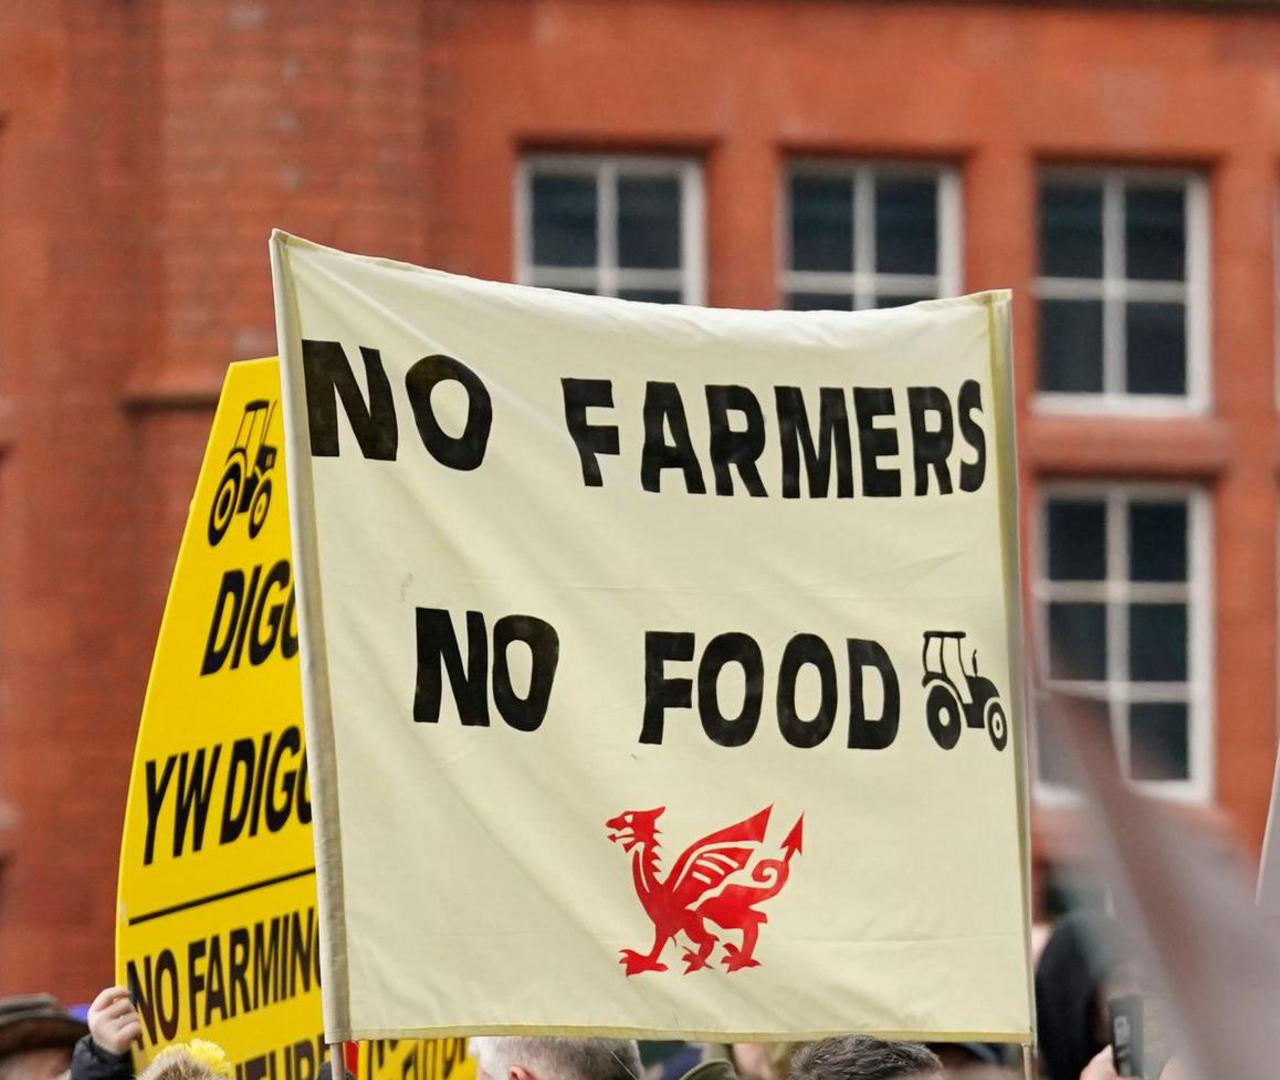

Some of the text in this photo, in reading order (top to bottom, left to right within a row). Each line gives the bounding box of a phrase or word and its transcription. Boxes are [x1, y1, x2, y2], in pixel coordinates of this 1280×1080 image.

[302, 339, 987, 499] NO FARMERS
[414, 607, 900, 750] NO FOOD
[143, 743, 222, 866] YW
[127, 907, 322, 1050] NO FARMIN
